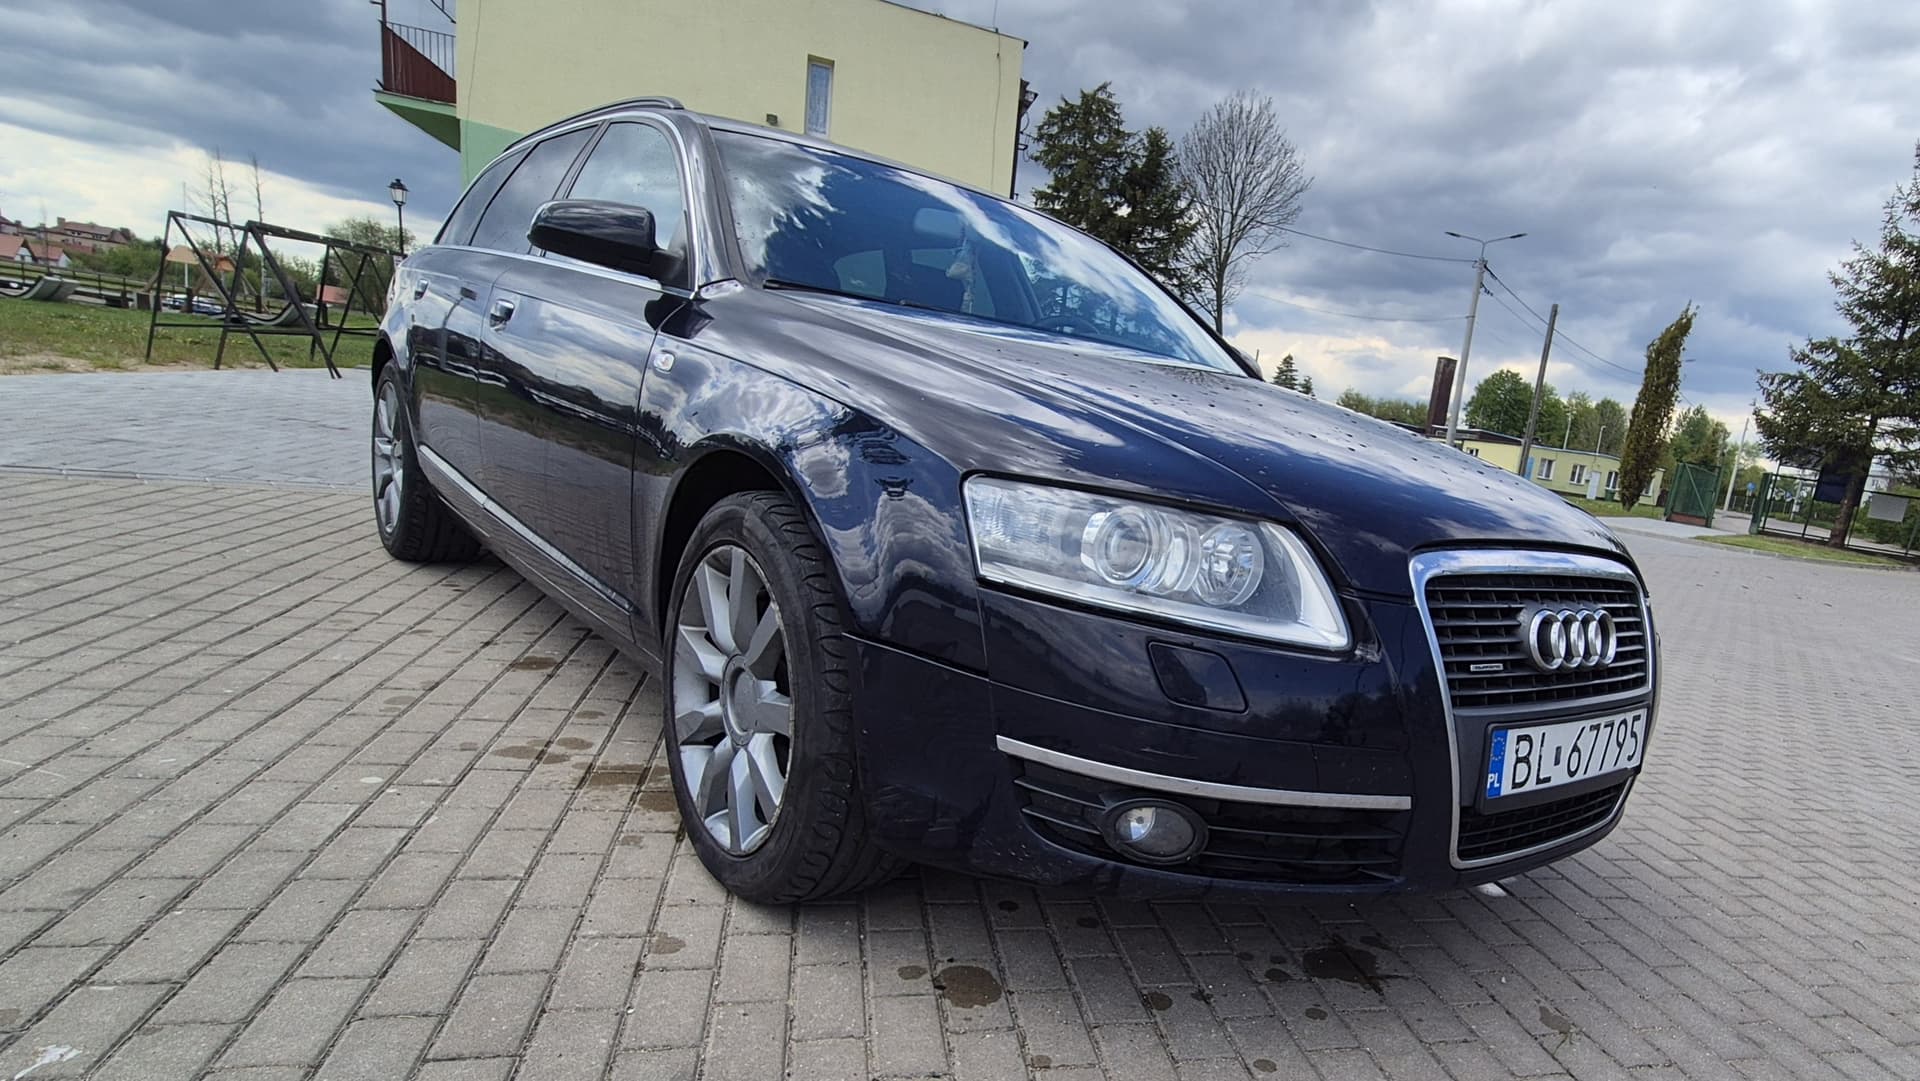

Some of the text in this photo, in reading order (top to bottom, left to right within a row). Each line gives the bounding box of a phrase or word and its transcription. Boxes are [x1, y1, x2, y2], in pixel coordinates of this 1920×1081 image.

[1511, 714, 1642, 790] BL 67795
[1487, 772, 1500, 788] PL
